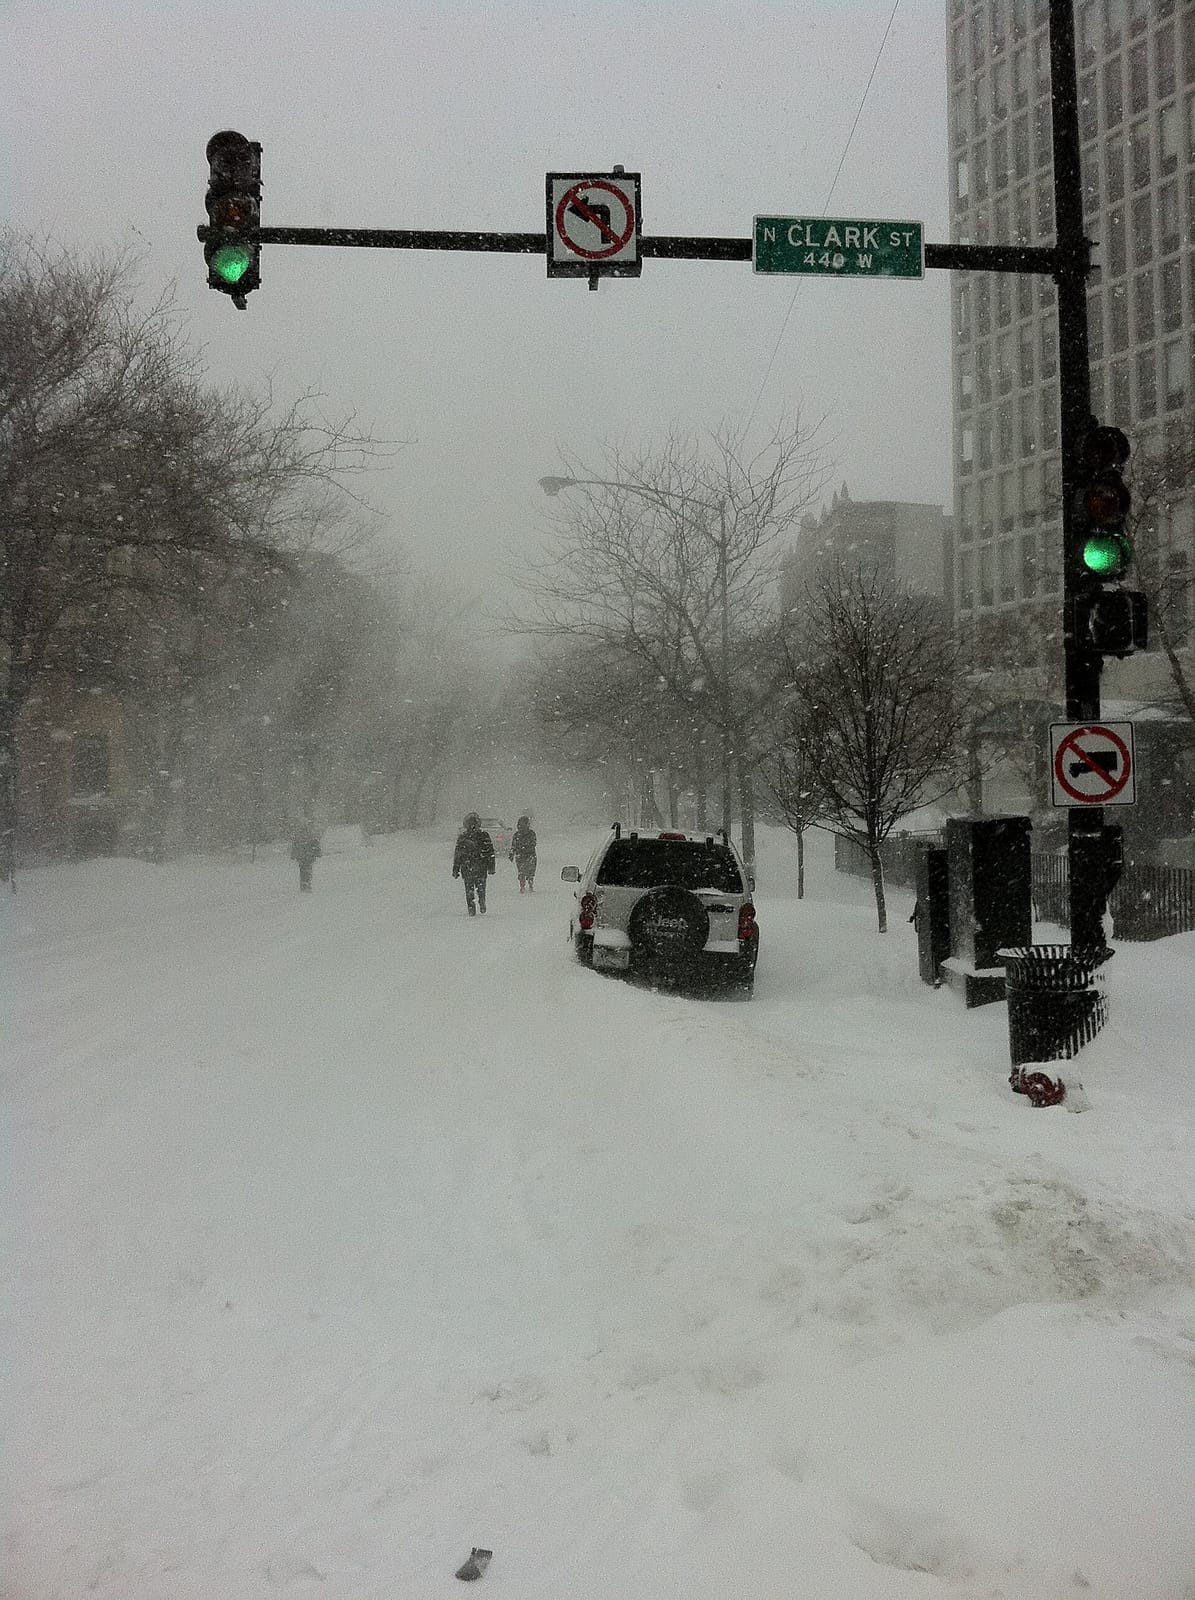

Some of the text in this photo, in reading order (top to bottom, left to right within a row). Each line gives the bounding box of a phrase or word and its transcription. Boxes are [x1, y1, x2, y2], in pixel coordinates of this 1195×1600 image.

[764, 224, 914, 249] N CLARK ST
[803, 252, 873, 269] 440 W
[652, 915, 689, 930] Jeep
